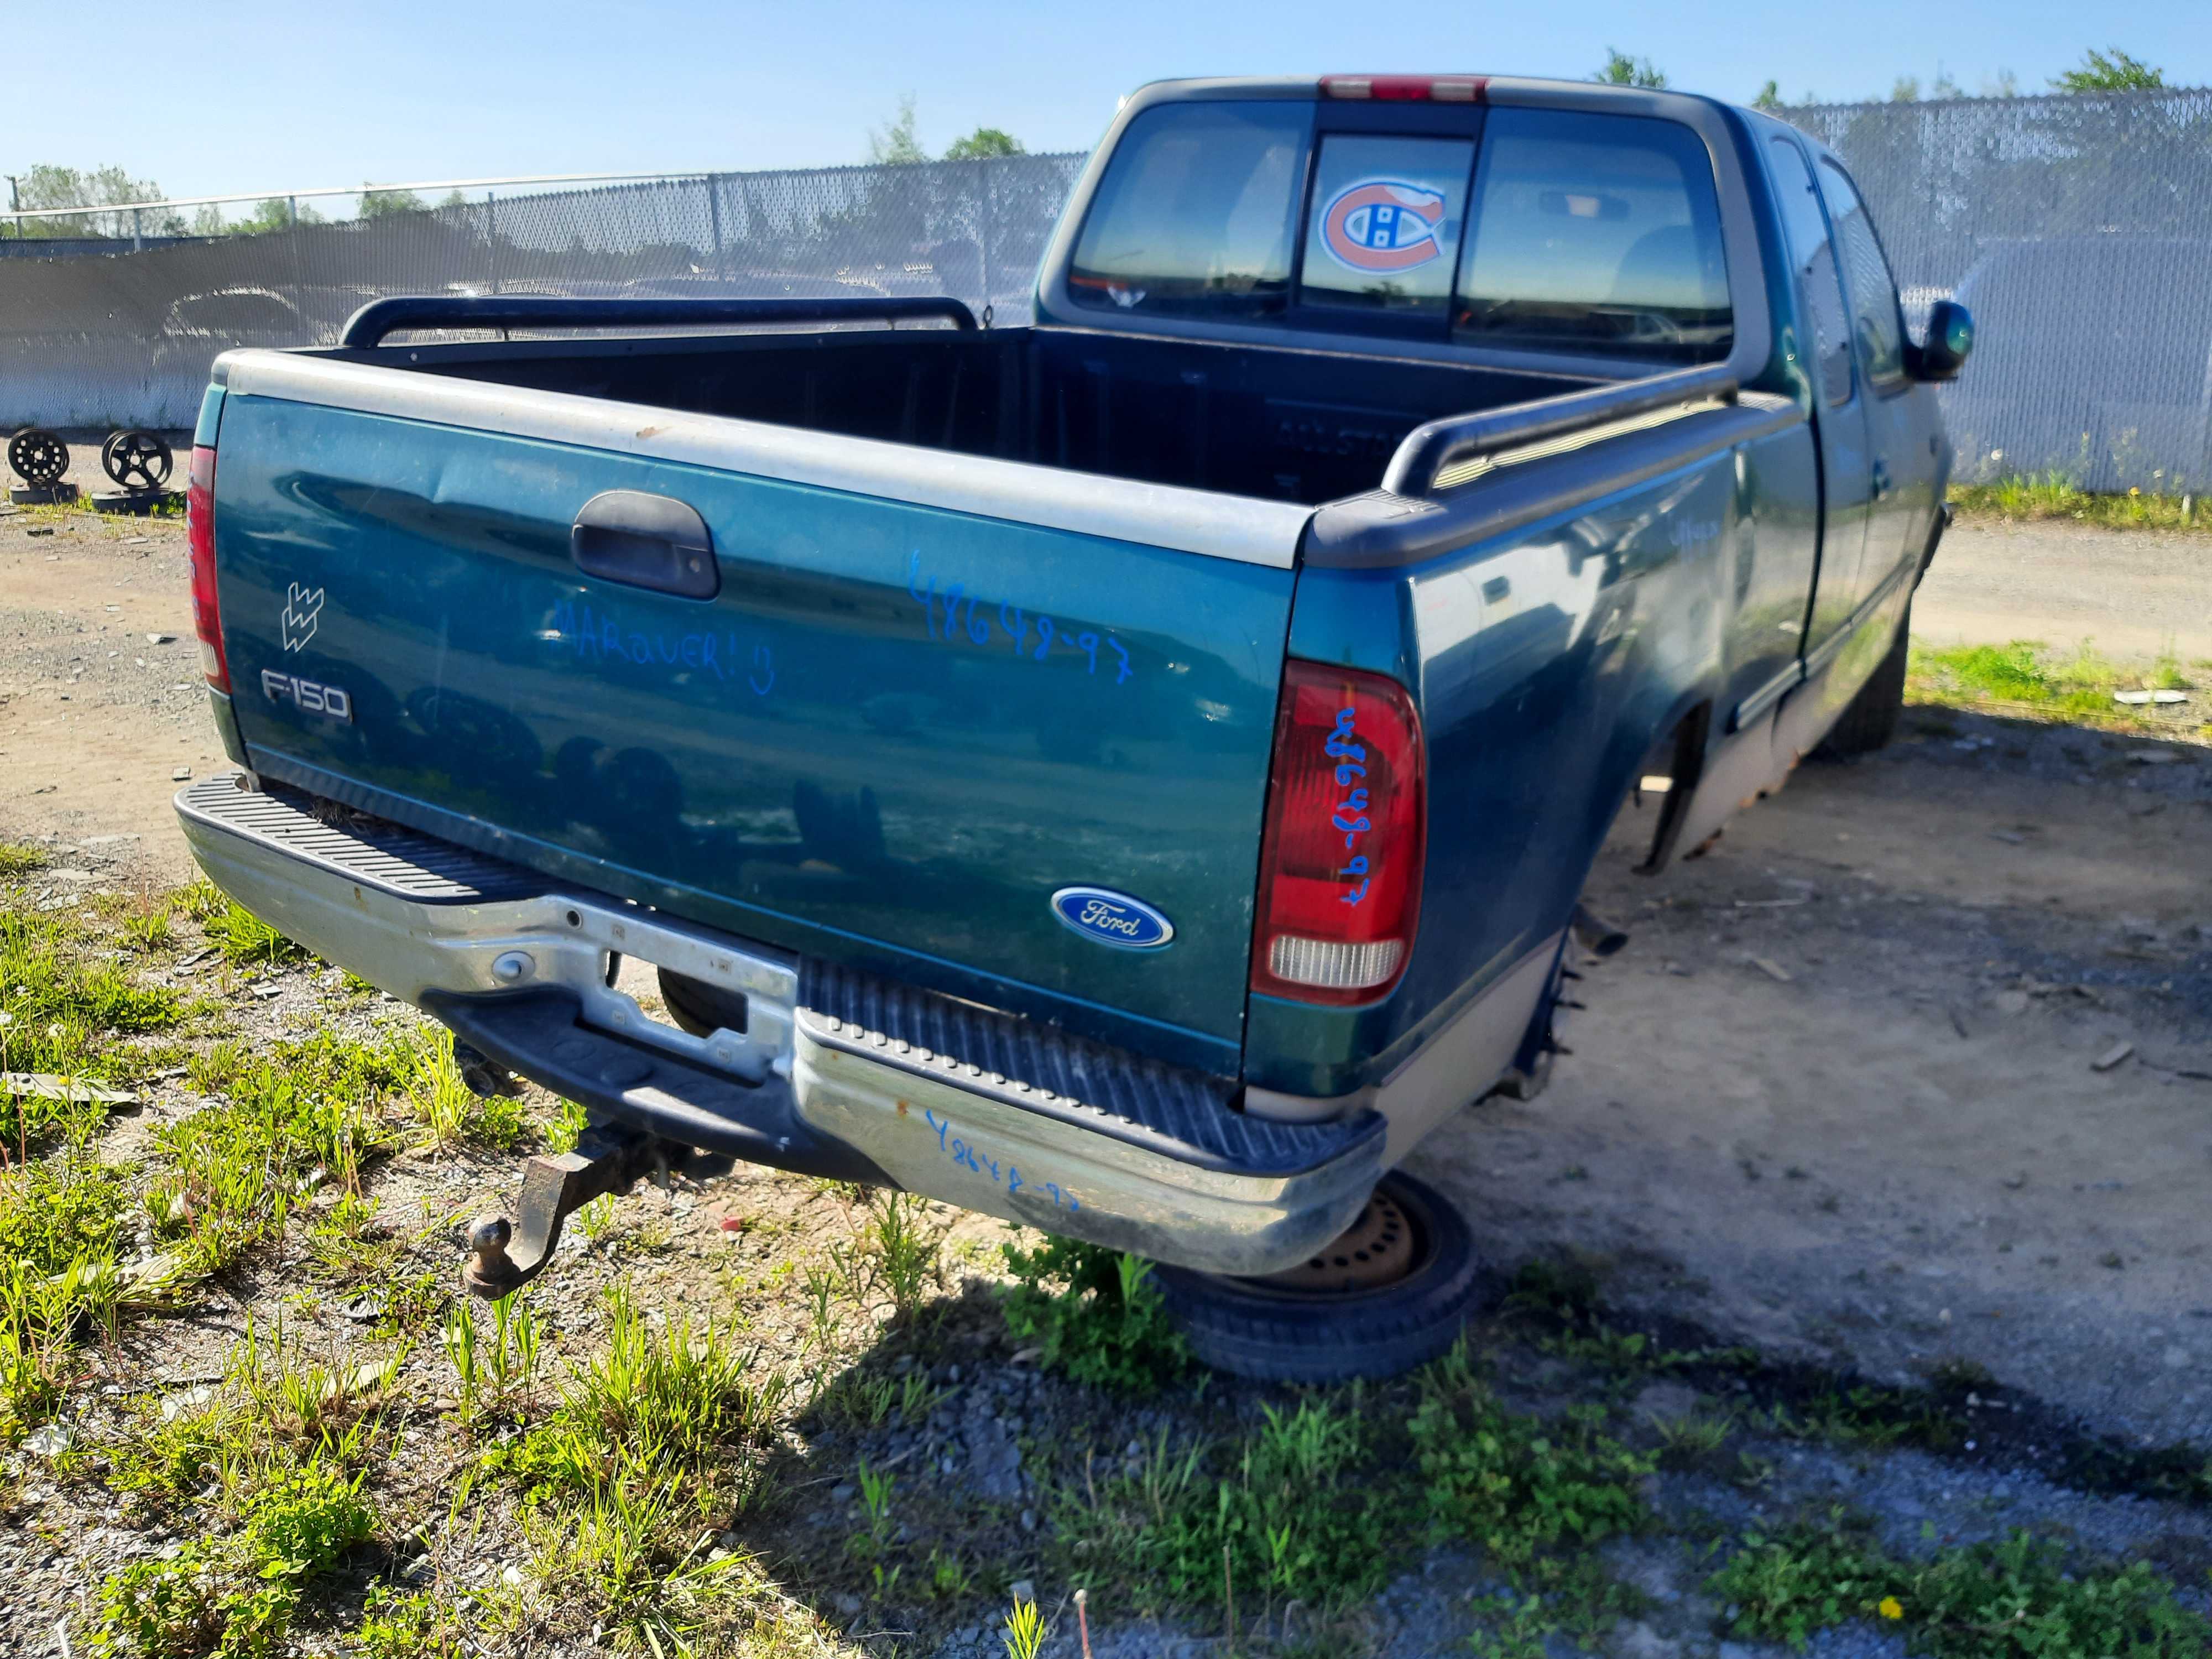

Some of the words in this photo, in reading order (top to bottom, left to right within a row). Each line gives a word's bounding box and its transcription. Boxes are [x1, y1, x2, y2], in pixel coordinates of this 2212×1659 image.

[910, 549, 1132, 684] 48648-97
[1324, 707, 1370, 905] 48648-97
[1081, 900, 1140, 935] Ford
